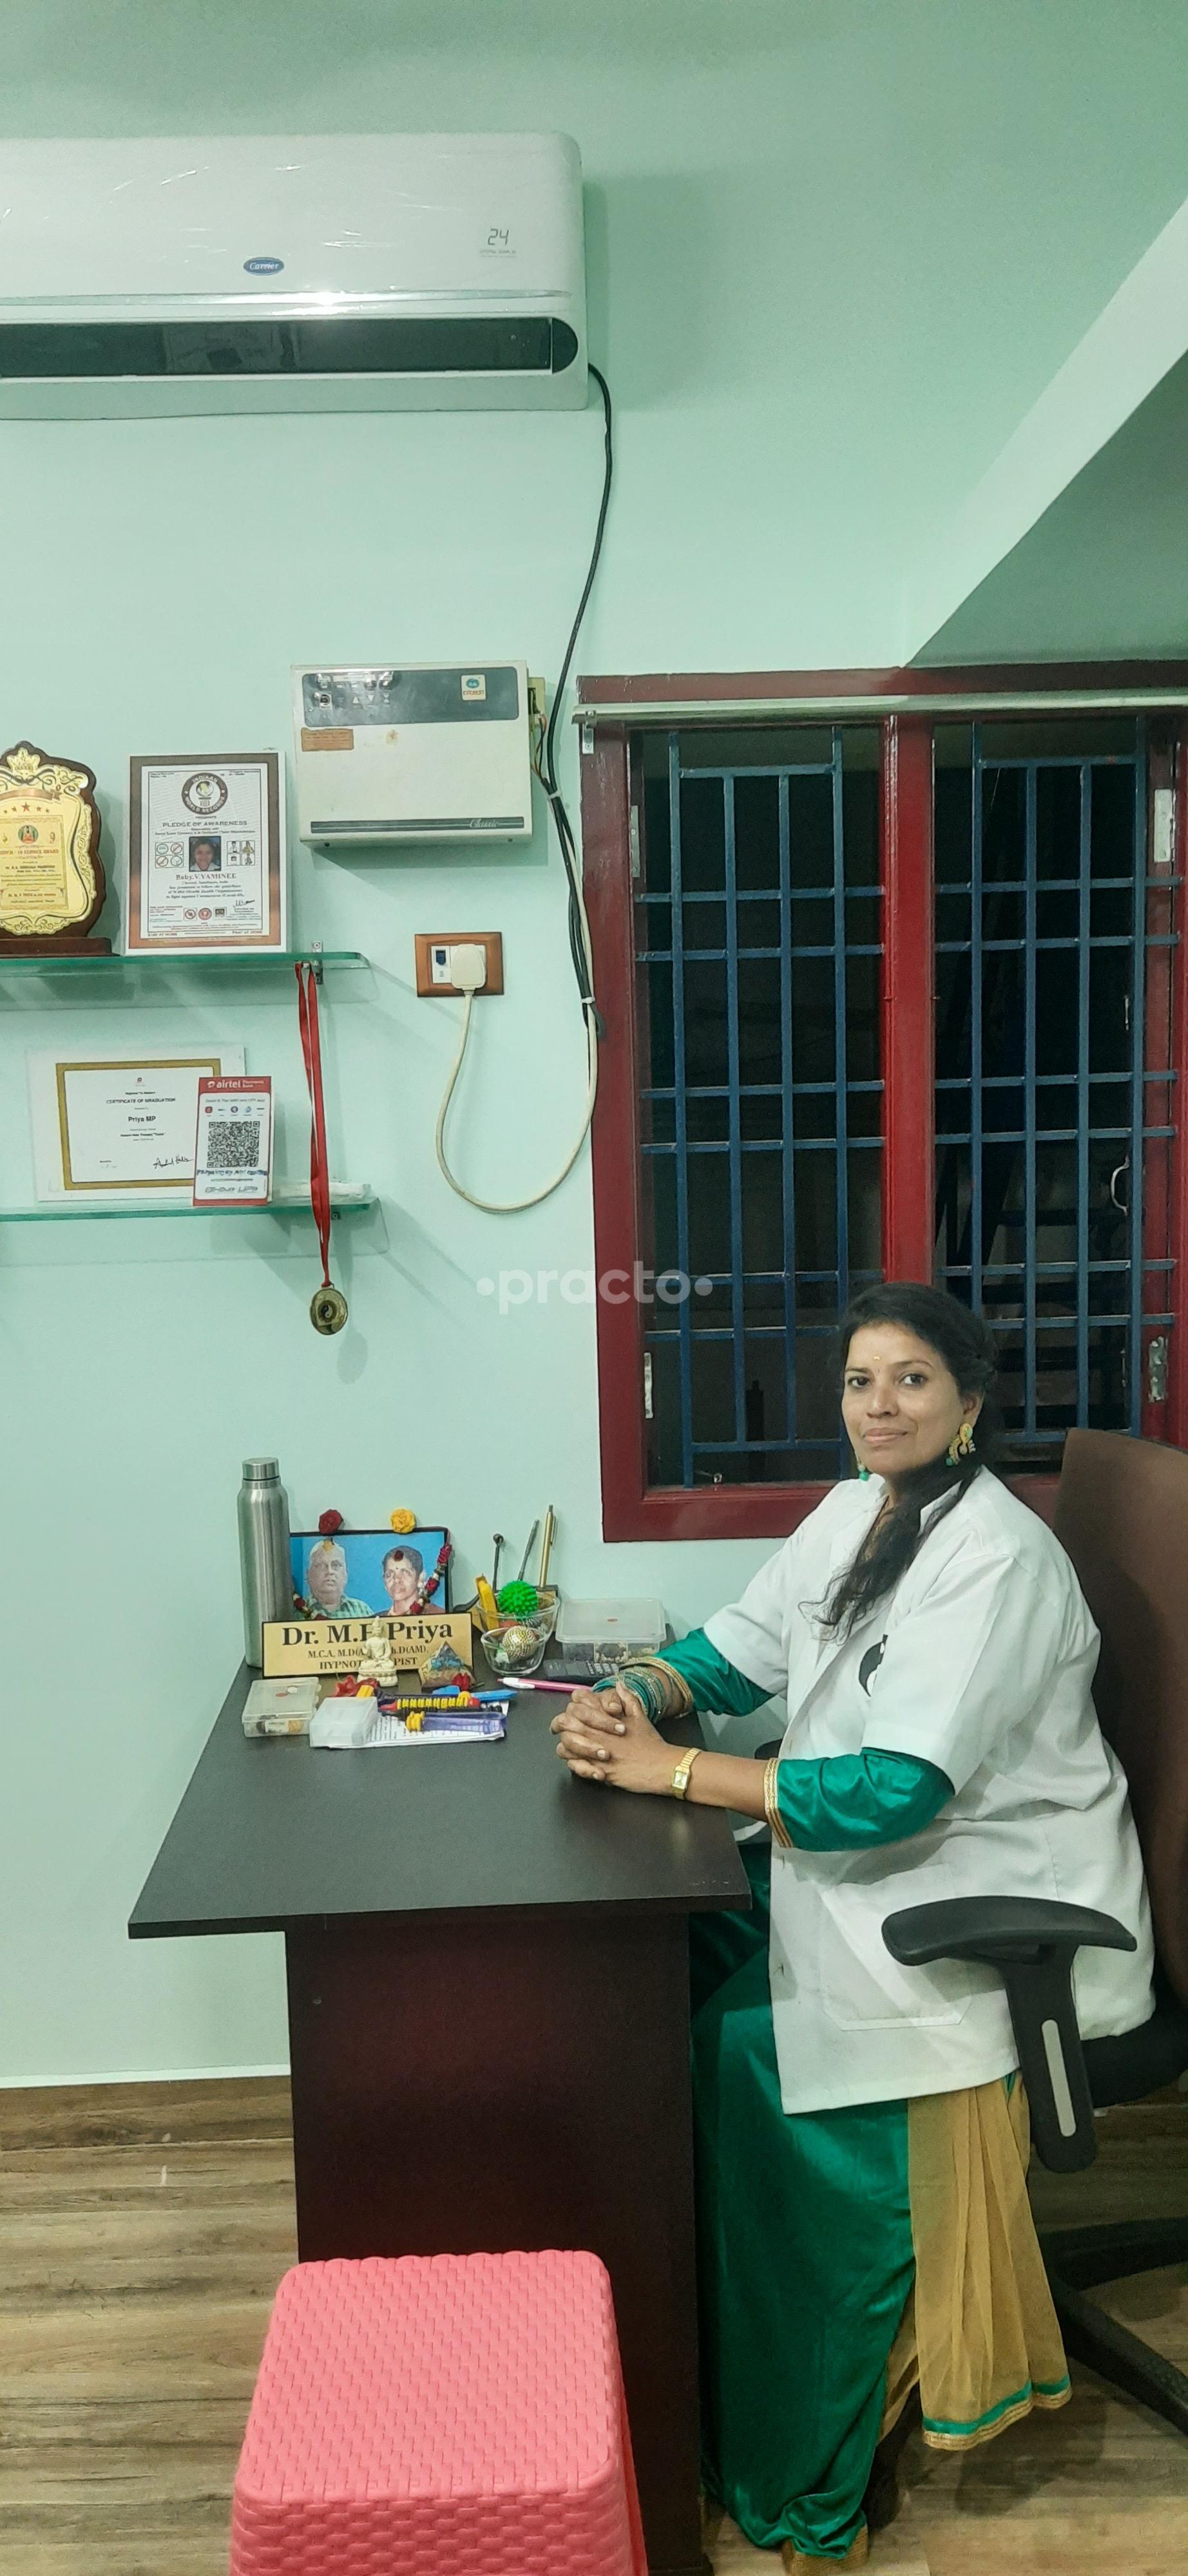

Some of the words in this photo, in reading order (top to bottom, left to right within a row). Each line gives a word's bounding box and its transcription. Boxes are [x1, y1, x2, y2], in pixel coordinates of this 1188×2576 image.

[487, 228, 510, 245] 24
[249, 261, 279, 270] Carrier
[470, 819, 499, 828] Classic
[216, 1079, 241, 1088] airtel
[282, 1627, 319, 1646] Dr.
[387, 1620, 454, 1643] Priya
